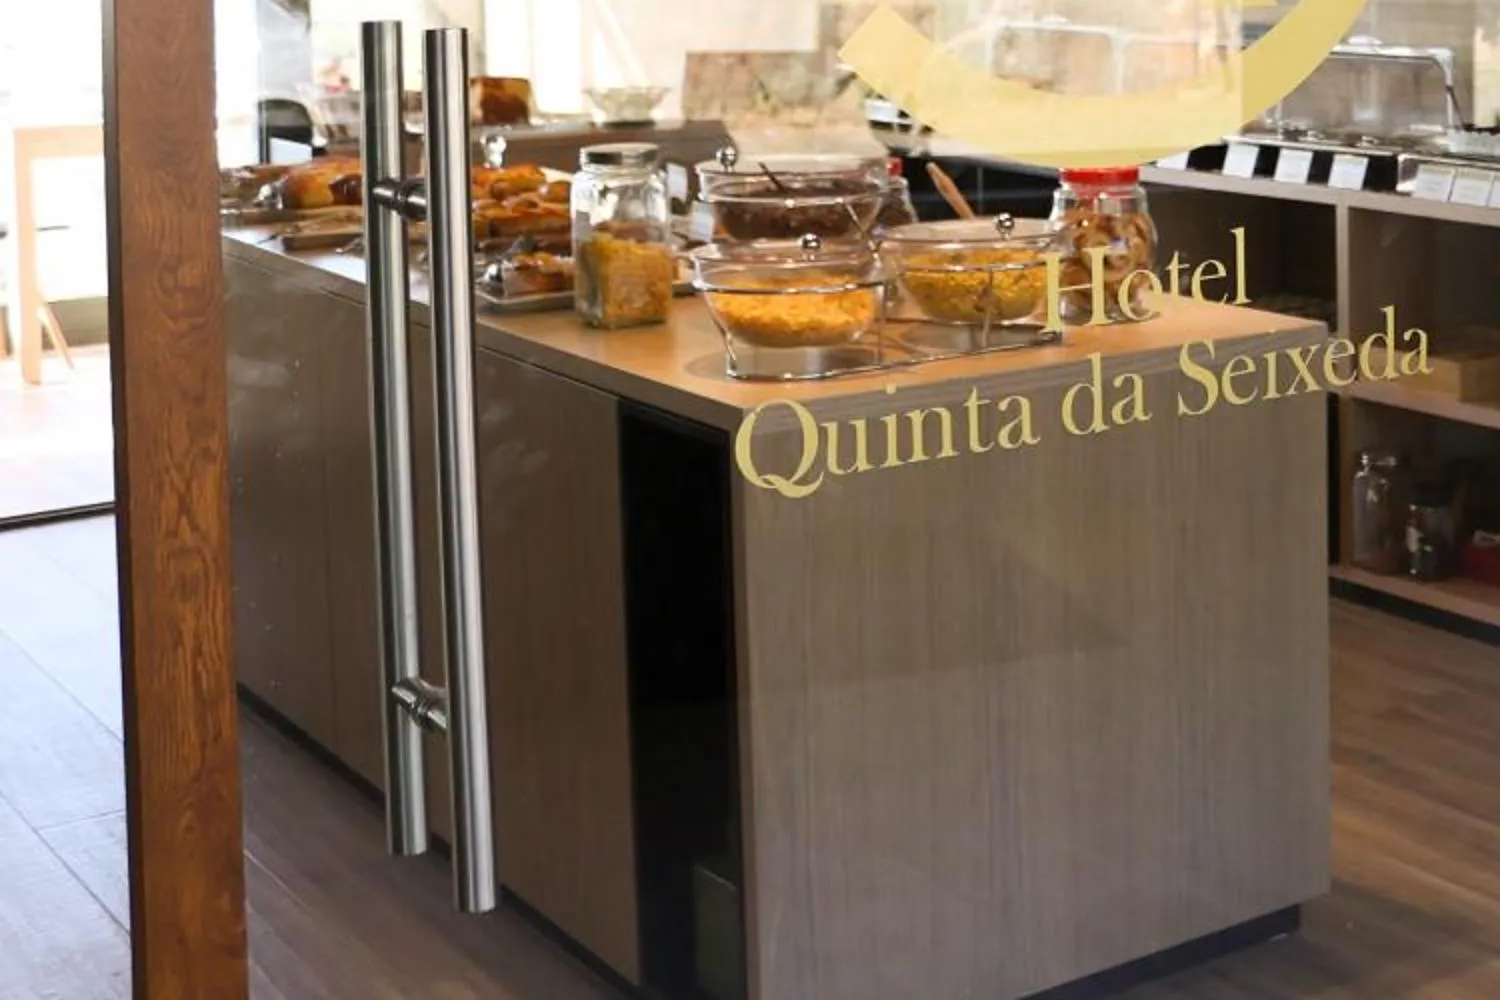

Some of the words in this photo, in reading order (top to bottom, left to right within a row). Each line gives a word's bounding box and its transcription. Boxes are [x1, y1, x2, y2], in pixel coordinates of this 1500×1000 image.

[1041, 227, 1253, 335] Hotel
[735, 385, 1041, 499] Quinta
[1061, 350, 1153, 437] da
[1177, 304, 1435, 417] Seixeda
